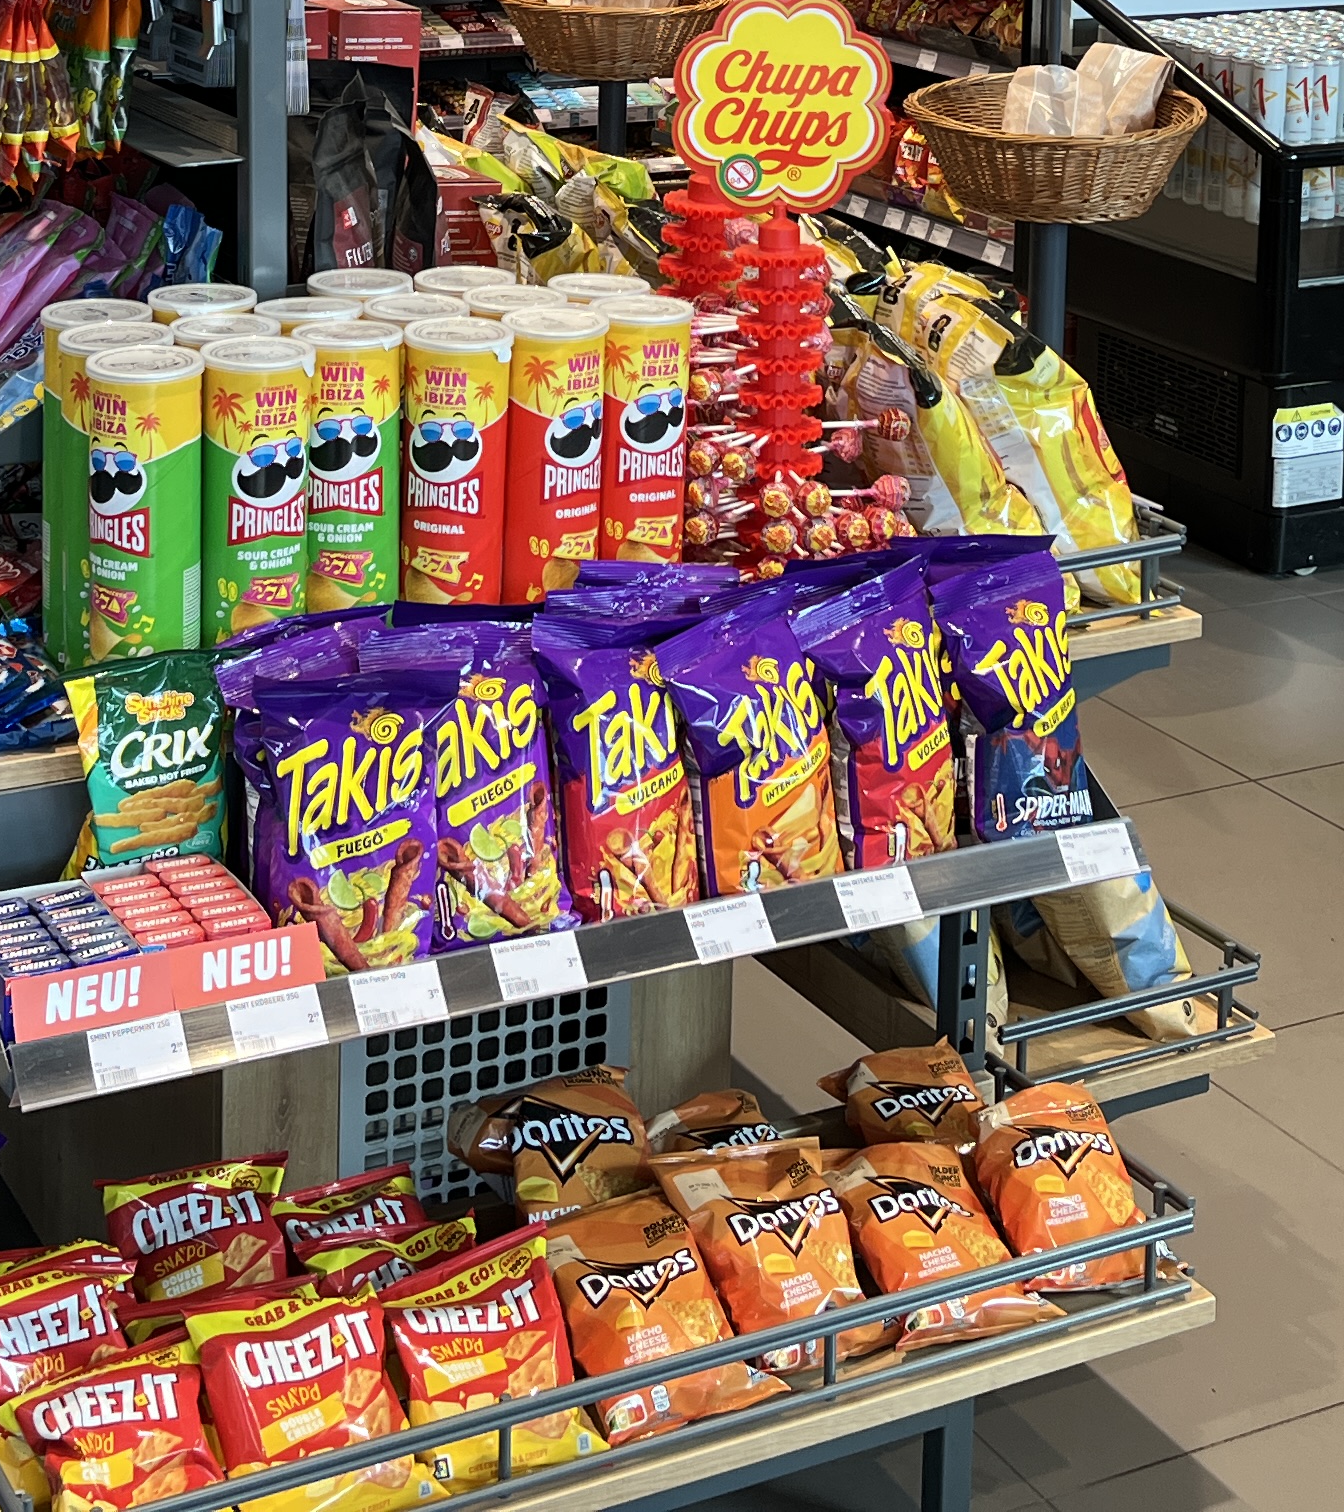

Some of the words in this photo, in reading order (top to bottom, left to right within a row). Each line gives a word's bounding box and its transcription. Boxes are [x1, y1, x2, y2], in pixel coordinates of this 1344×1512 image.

[715, 49, 861, 108] Chupa
[704, 98, 852, 174] Chups
[642, 342, 680, 359] WIN
[321, 365, 365, 382] WIN
[568, 354, 600, 373] WIN
[642, 362, 679, 377] IBIZA
[425, 372, 468, 388] WIN
[568, 374, 600, 391] IBIZA
[93, 394, 127, 416] WIN
[256, 389, 298, 408] WIN
[320, 388, 365, 402] IBIZA
[424, 391, 467, 407] IBIZA
[92, 419, 127, 437] IBIZA
[255, 410, 298, 428] IBIZA
[618, 444, 683, 482] PRINGLES
[544, 455, 601, 501] PRINGLE
[307, 470, 380, 511] PRINGLES
[407, 475, 480, 515] PRINGLES
[629, 489, 677, 503] ORIGINAL
[231, 496, 306, 541] PRINGLES
[555, 503, 597, 519] ORIGINAL
[308, 522, 333, 534] SOUR
[336, 522, 374, 534] CREAM
[327, 532, 362, 544] ONION
[414, 520, 465, 535] ORIGINAL
[237, 549, 259, 561] SOUR
[262, 543, 301, 559] CREAM
[260, 556, 293, 570] ONION
[96, 567, 126, 581] ONION
[104, 559, 138, 572] CREAM
[973, 611, 1071, 728] Takis
[126, 691, 194, 711] Sunshine
[137, 705, 185, 724] Snacks
[718, 658, 822, 802] Takis
[110, 725, 214, 779] CRIX
[435, 684, 537, 799] akis
[574, 684, 677, 808] Taki
[125, 775, 158, 789] BAKED
[159, 771, 178, 782] NOT
[181, 764, 206, 778] FRIED
[277, 728, 425, 856] Takis
[471, 779, 515, 812] FUEGO
[628, 768, 679, 808] VOLCANO
[765, 772, 801, 804] INTENSE
[1012, 789, 1093, 824] SPIDER-MAN
[337, 831, 384, 860] FUEGO
[202, 937, 292, 994] NEU!
[46, 965, 142, 1026] NEU!
[89, 1030, 111, 1043] SMINT
[112, 1022, 155, 1040] PEPPERMINT
[874, 1084, 976, 1120] Doritos
[1015, 1132, 1114, 1168] Doritos
[730, 1189, 841, 1244] Doritos
[1050, 1201, 1087, 1218] CHEESE
[406, 1237, 431, 1257] GO!
[918, 1246, 951, 1263] NACHO
[922, 1253, 957, 1269] CHEESE
[162, 1264, 203, 1288] DOUBLE
[415, 1288, 455, 1306] GRAB
[471, 1263, 497, 1287] GO!
[580, 1248, 696, 1305] Doritos
[780, 1272, 814, 1290] NACHO
[166, 1276, 203, 1300] CHEESE
[782, 1281, 819, 1300] CHEESE
[244, 1301, 286, 1327] GRAB
[627, 1324, 663, 1345] NACHO
[629, 1333, 668, 1353] CHEESE
[280, 1408, 324, 1434] DOUBLE
[285, 1418, 326, 1443] CHEESE
